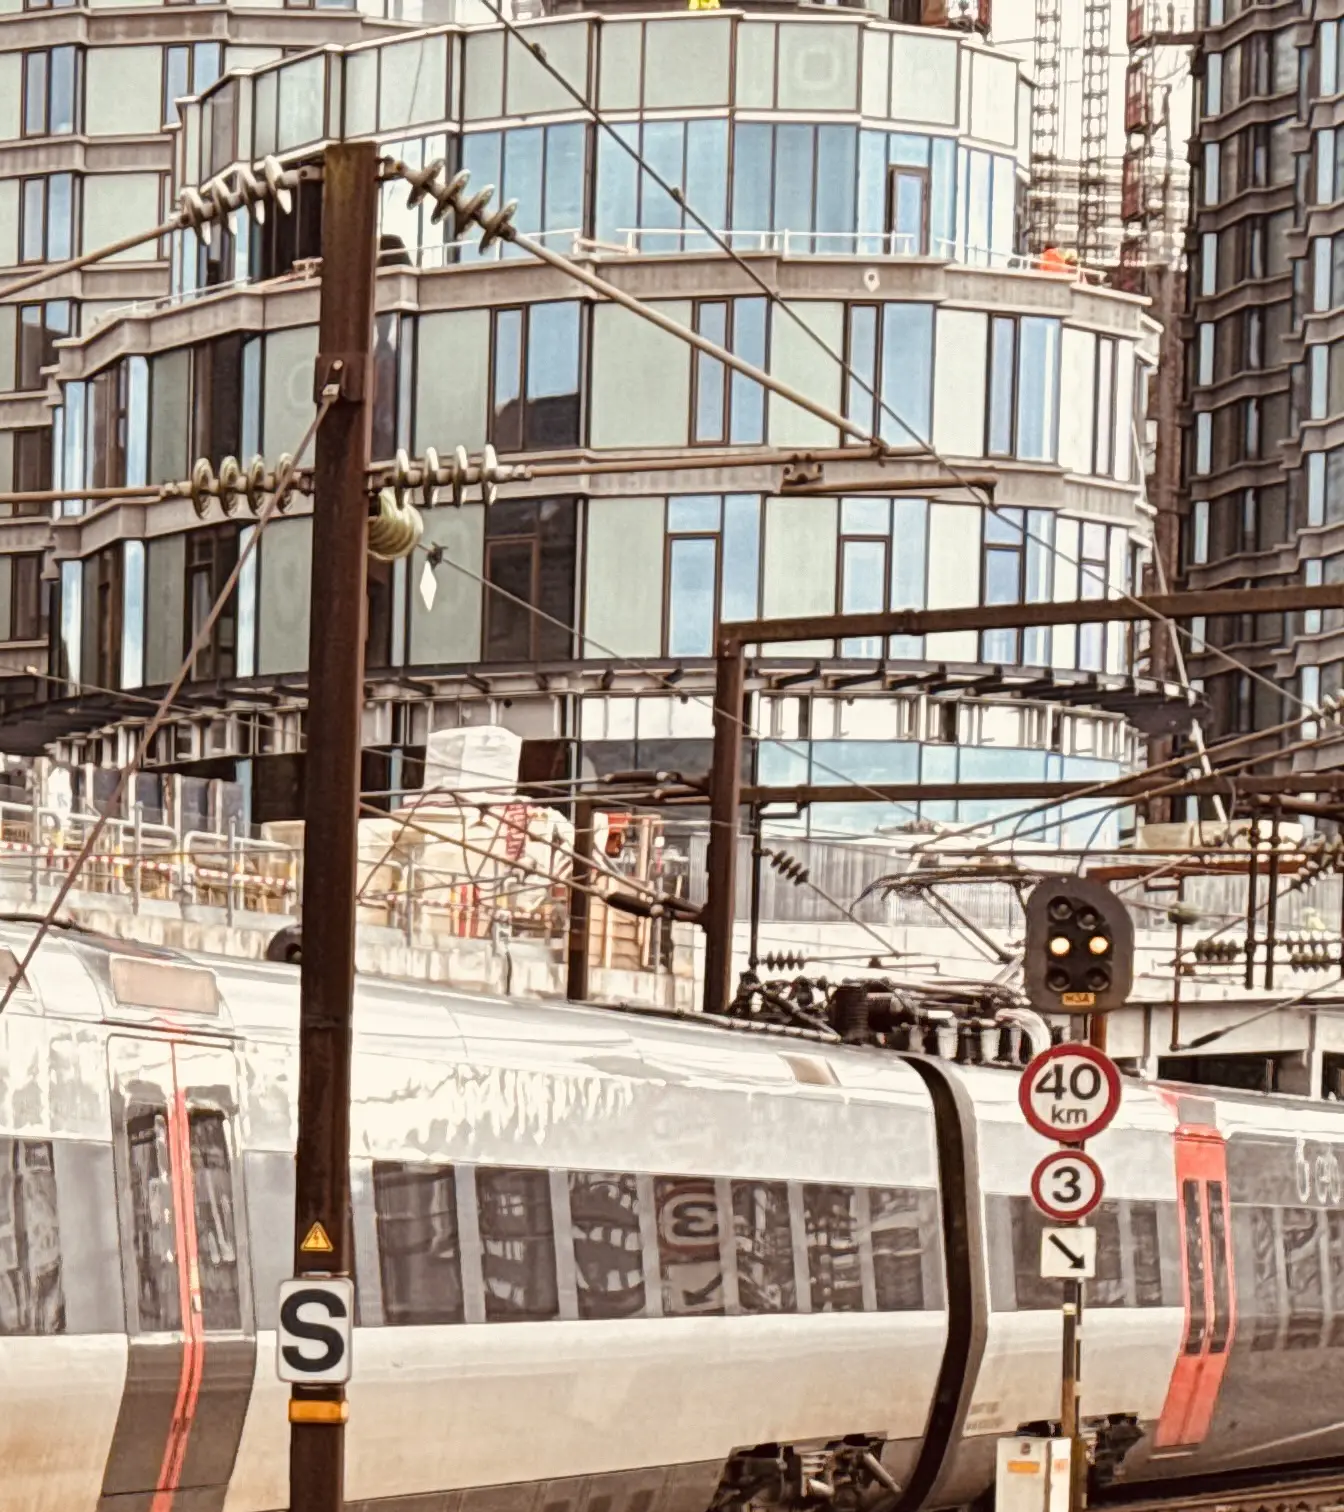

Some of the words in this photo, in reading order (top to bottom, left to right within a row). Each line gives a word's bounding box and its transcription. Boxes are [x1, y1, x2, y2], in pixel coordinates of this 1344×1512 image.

[1035, 1063, 1102, 1101] 40
[1051, 1104, 1088, 1124] km
[1052, 1166, 1082, 1203] 3
[279, 1287, 347, 1373] S
